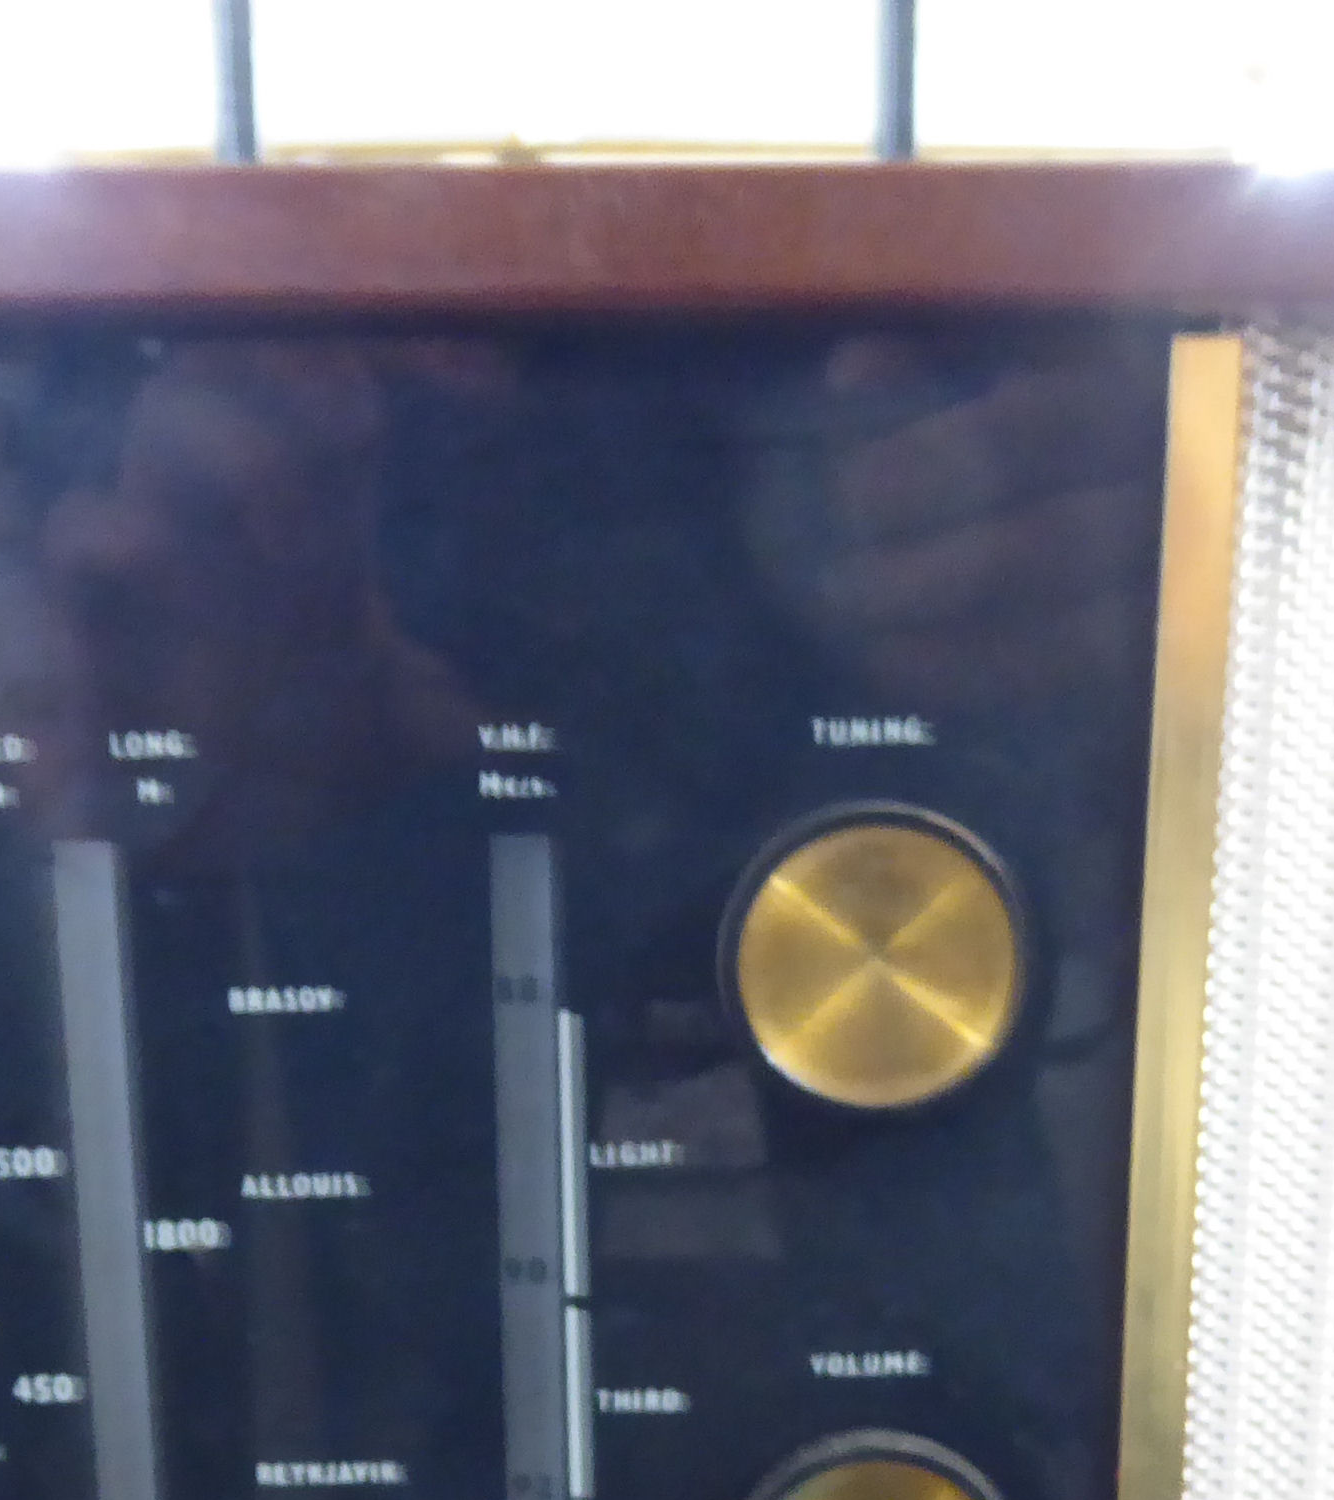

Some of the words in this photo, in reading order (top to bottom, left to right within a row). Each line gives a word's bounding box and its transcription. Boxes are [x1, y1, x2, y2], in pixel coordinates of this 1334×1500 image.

[108, 730, 197, 760] LONG
[811, 716, 933, 746] TUNING
[589, 1138, 682, 1168] LIGHT
[240, 1172, 370, 1201] ALLOUIS
[144, 1218, 230, 1250] 1800
[809, 1350, 929, 1378] VOLUME
[13, 1373, 83, 1403] 450
[598, 1387, 688, 1413] THIRD
